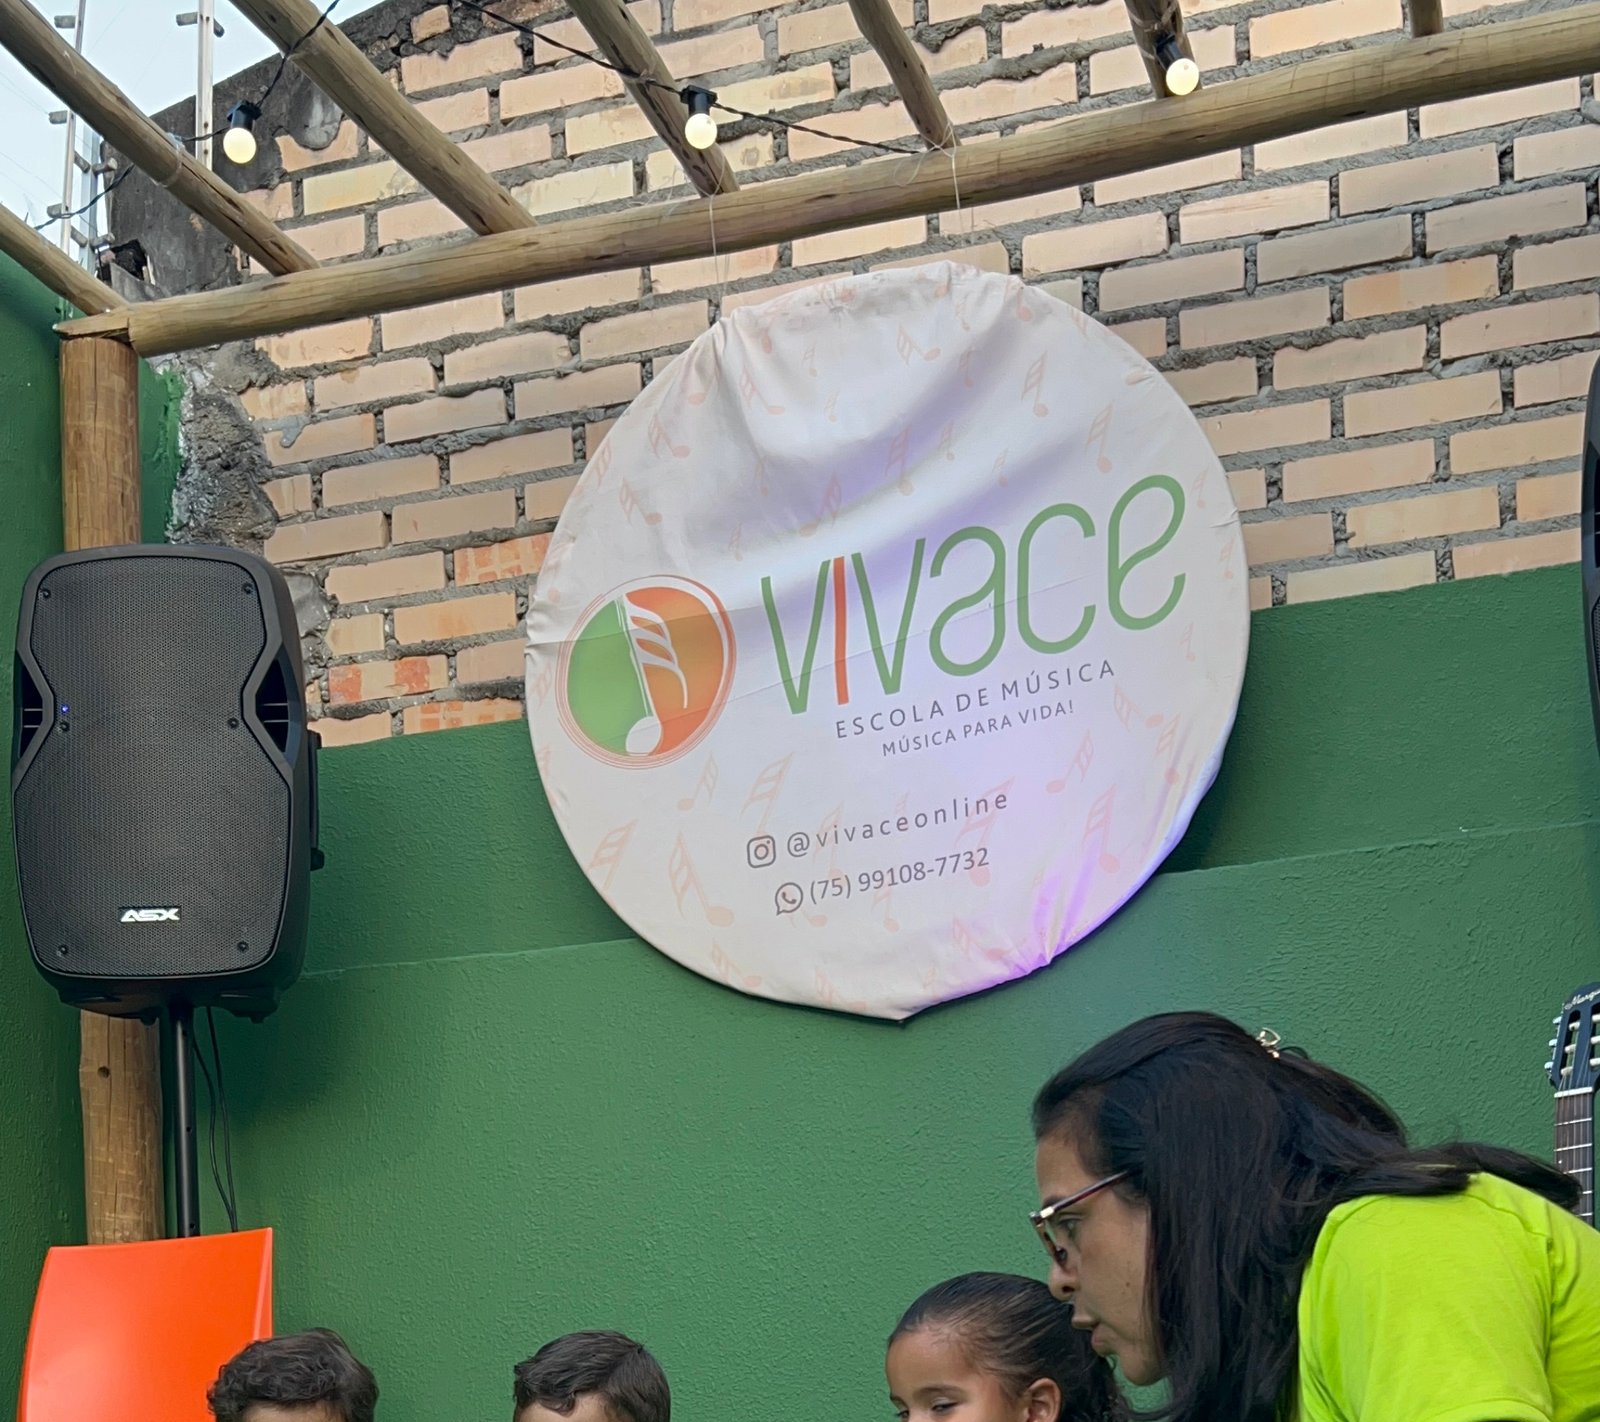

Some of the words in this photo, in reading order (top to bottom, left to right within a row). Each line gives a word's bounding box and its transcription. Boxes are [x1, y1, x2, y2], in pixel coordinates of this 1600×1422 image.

[835, 700, 944, 739] ESCOLA
[956, 688, 989, 713] DE
[1001, 660, 1115, 701] MÚSICA
[882, 729, 956, 757] MÚSICA
[963, 714, 1012, 739] PARA
[1018, 700, 1074, 725] VIDA!
[787, 793, 1008, 858] @vivaceonline
[810, 874, 851, 905] (75)
[858, 847, 990, 892] 99108-7732
[120, 908, 180, 923] ASX
